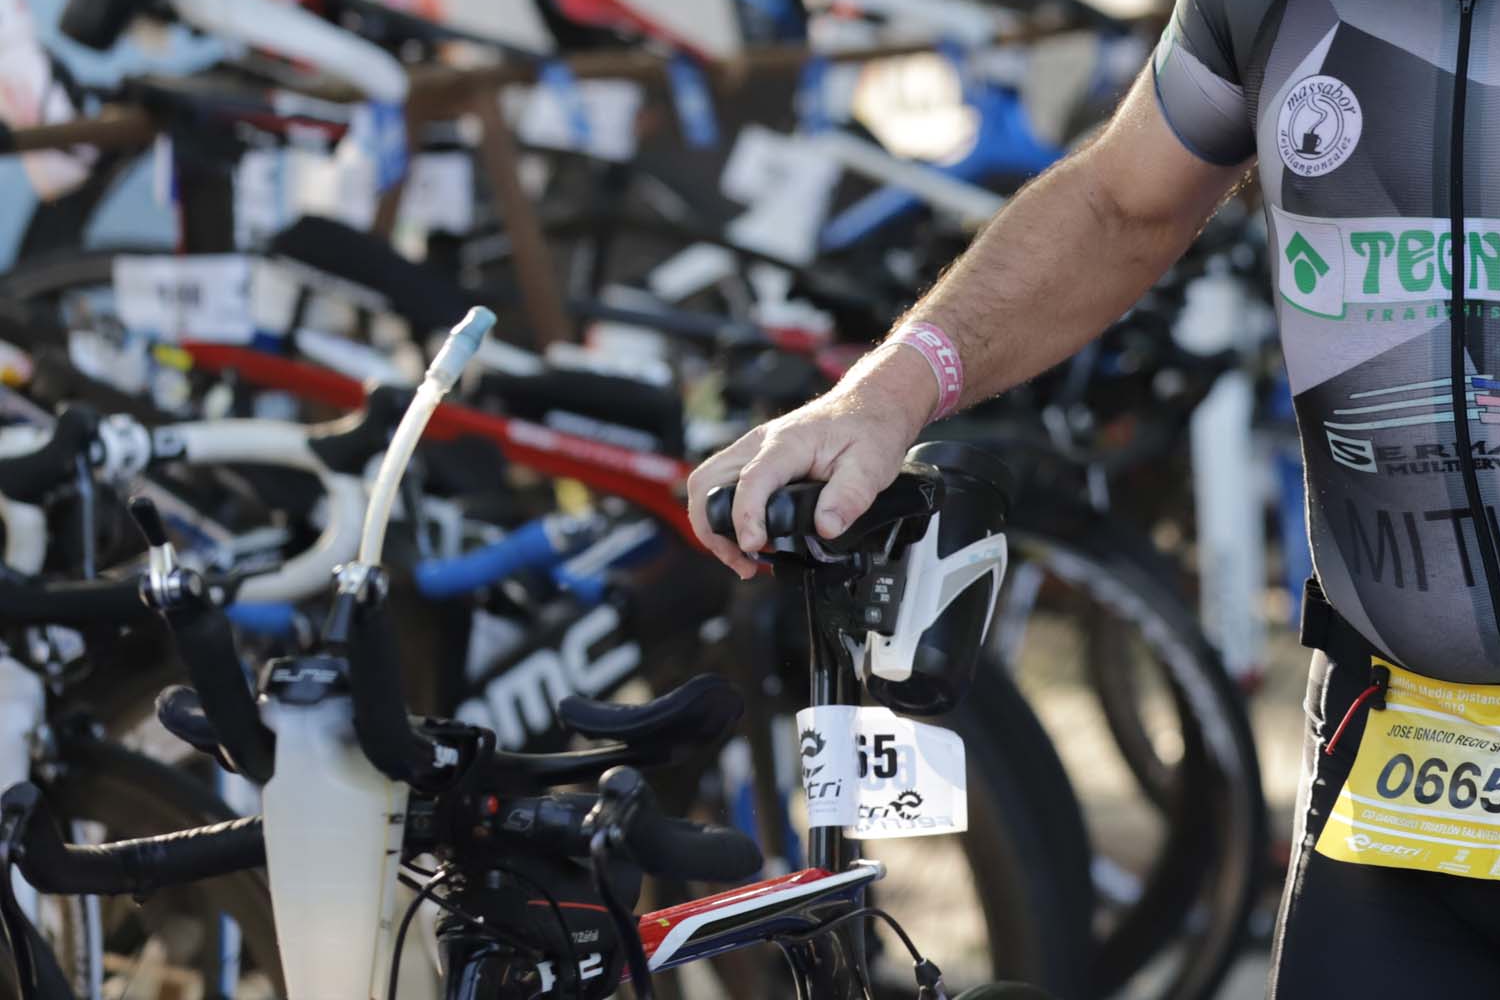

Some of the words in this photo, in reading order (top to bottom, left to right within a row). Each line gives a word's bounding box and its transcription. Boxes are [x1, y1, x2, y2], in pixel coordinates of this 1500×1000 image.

[1286, 81, 1357, 114] massabor
[1387, 724, 1411, 739] JOSE
[1413, 728, 1456, 744] IGNACIO
[1455, 734, 1489, 750] RECIO
[807, 778, 843, 801] tri
